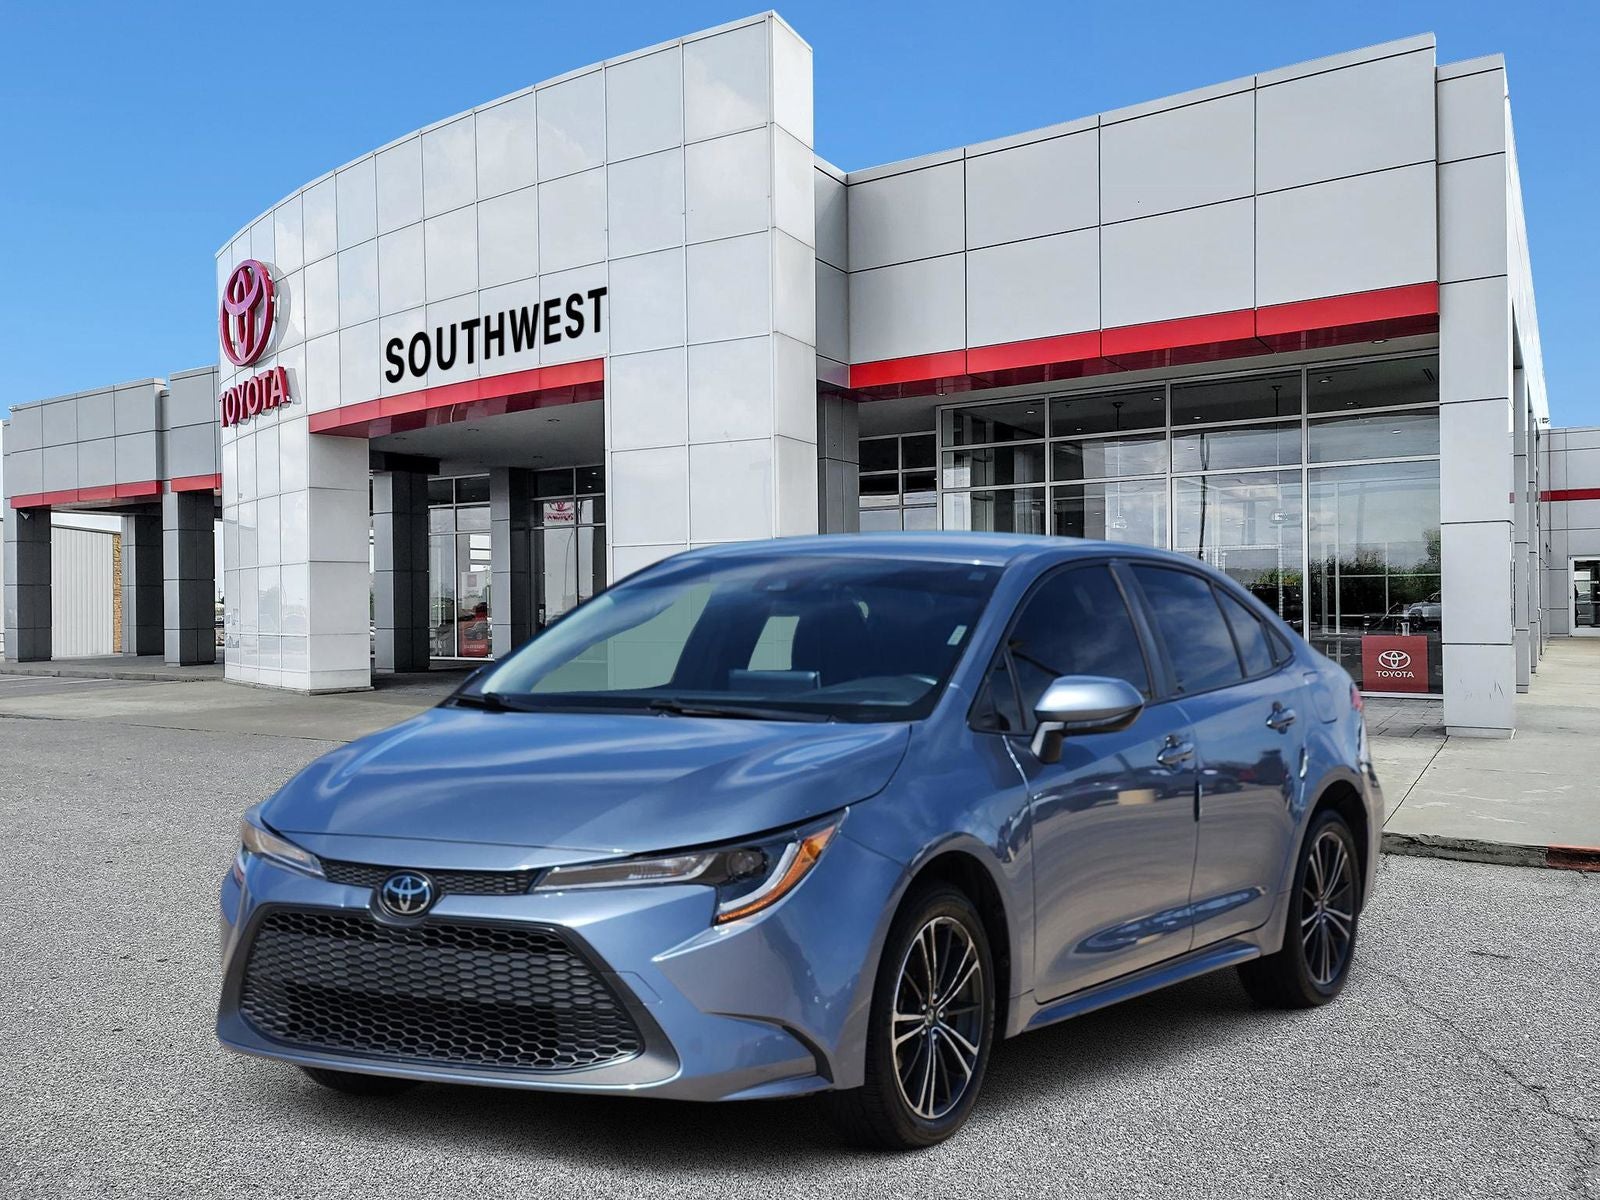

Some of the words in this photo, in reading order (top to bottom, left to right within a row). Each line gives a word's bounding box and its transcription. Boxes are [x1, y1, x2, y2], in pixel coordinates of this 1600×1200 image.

[385, 286, 607, 384] SOUTHWEST
[218, 366, 289, 427] TOYOTA
[1376, 670, 1415, 678] TOYOTA
